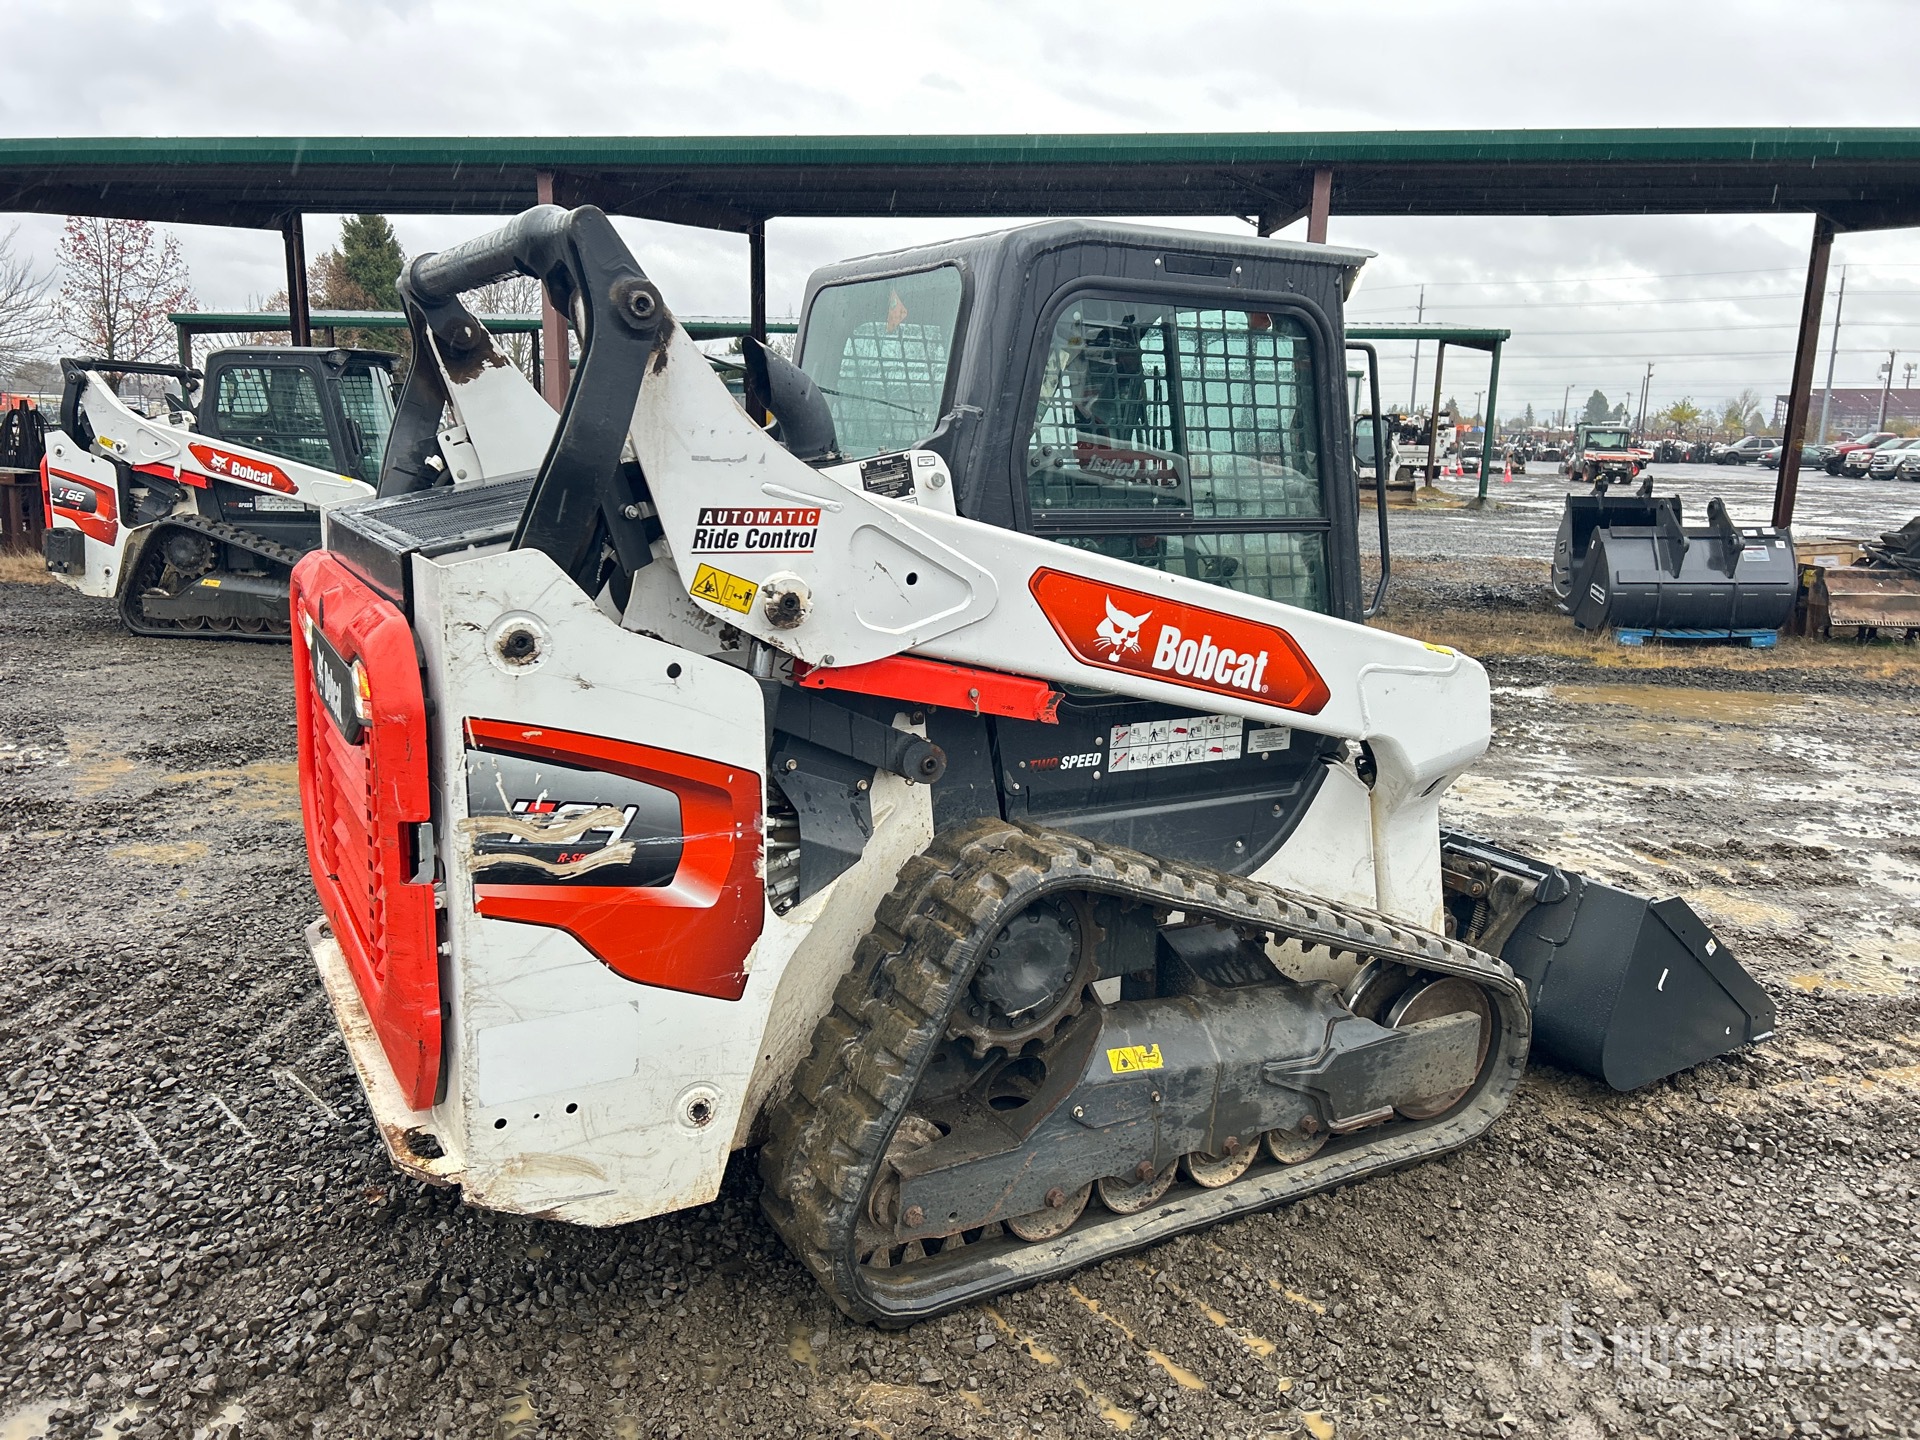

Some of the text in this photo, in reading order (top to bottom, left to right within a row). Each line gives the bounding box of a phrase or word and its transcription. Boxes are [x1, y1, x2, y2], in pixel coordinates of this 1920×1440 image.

[231, 462, 273, 485] Bobcat
[59, 487, 86, 502] T66
[702, 511, 817, 524] AUTOMATIC
[693, 528, 817, 548] Ride Control
[1152, 624, 1269, 693] Bobcat
[1030, 752, 1102, 772] TWO SPEED
